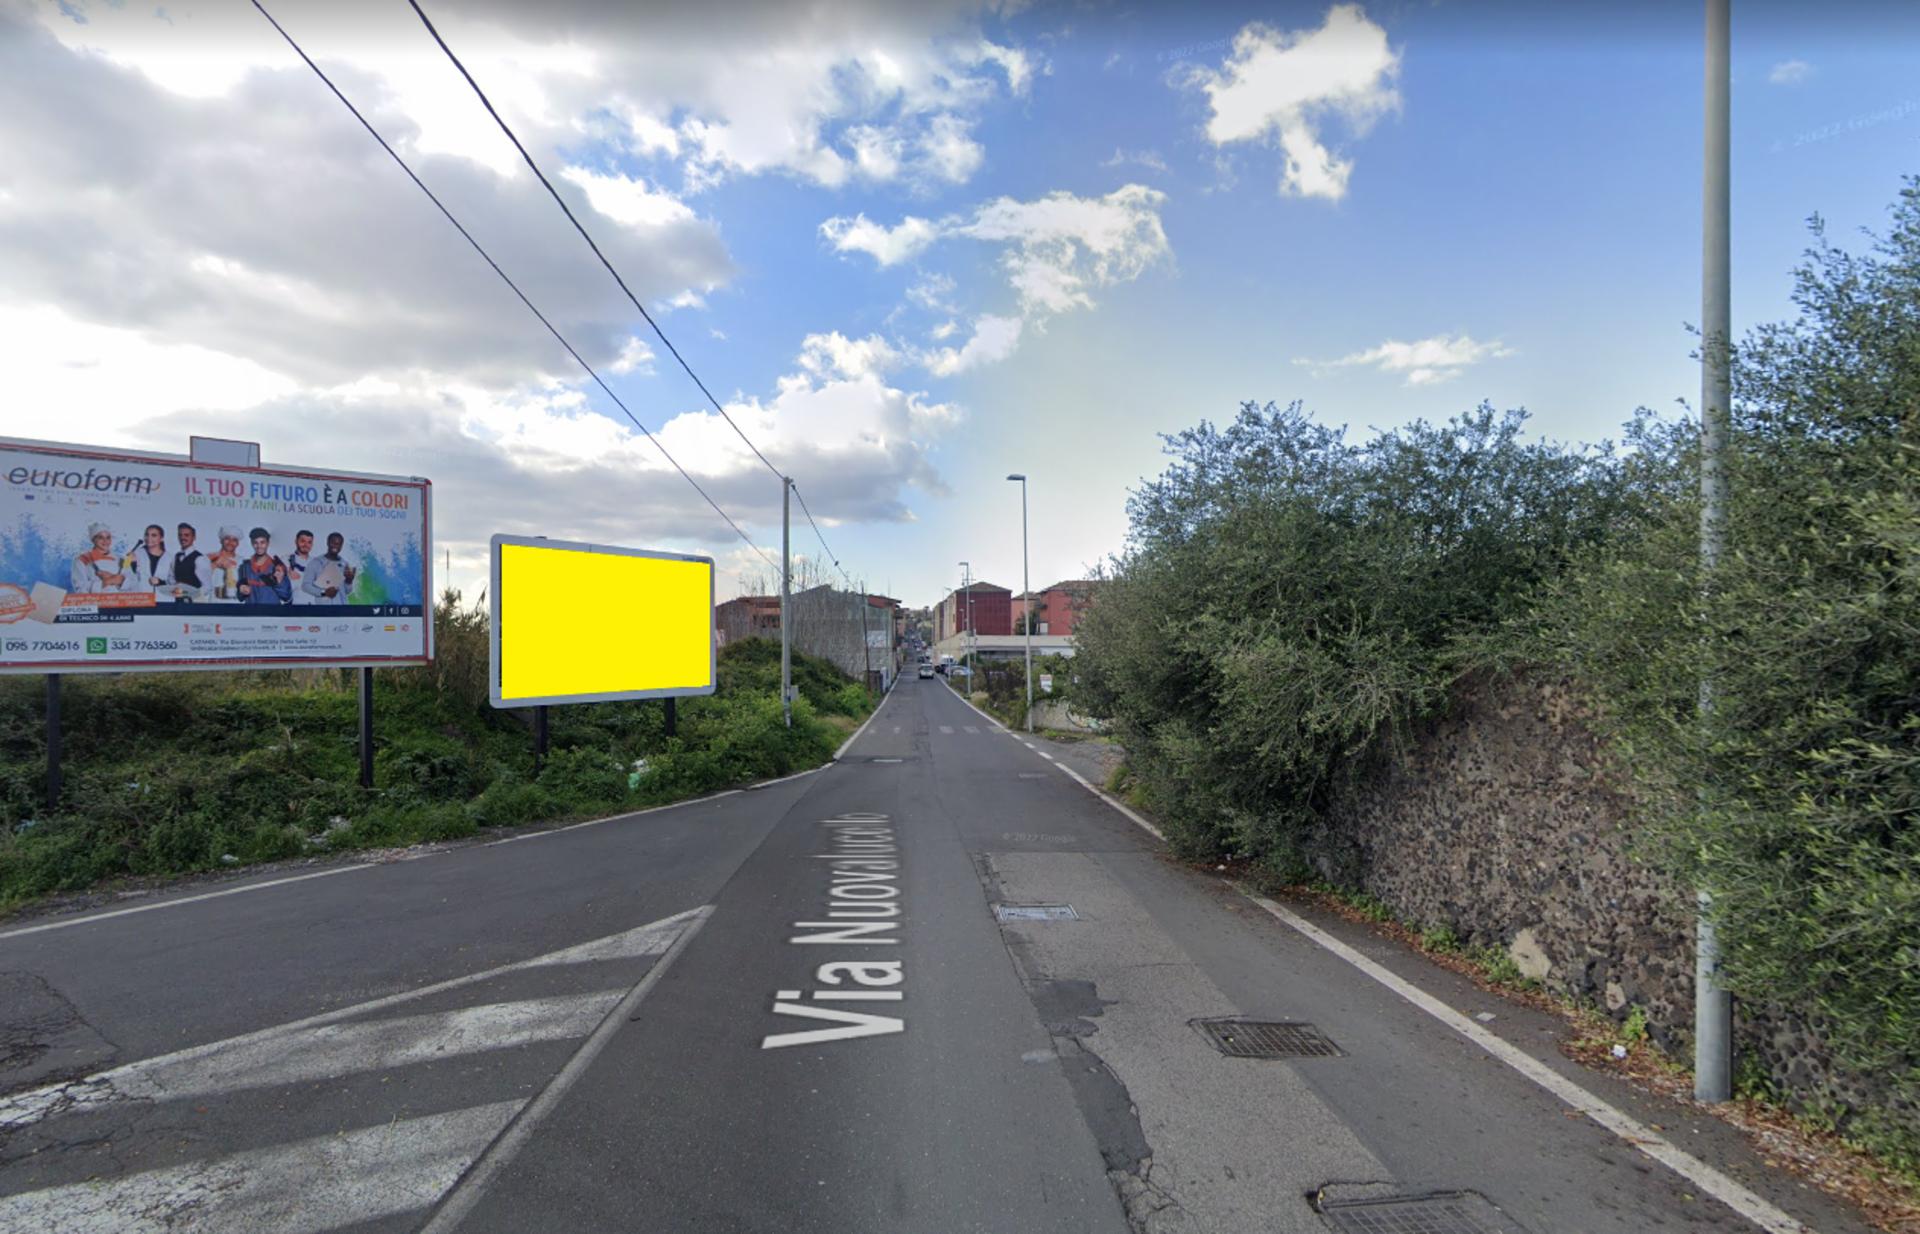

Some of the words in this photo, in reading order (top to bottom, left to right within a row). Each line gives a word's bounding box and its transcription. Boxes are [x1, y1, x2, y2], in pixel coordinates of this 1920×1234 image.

[9, 466, 152, 494] euroform
[185, 477, 202, 495] IL
[205, 478, 244, 498] TUO
[250, 481, 318, 503] FUTURO
[323, 483, 333, 504] È
[337, 488, 347, 504] A
[352, 490, 409, 510] COLORI
[284, 502, 295, 513] LA
[297, 503, 335, 515] SCUOLA
[379, 508, 407, 519] SOGNI
[6, 641, 28, 651] 095
[111, 641, 131, 650] 334
